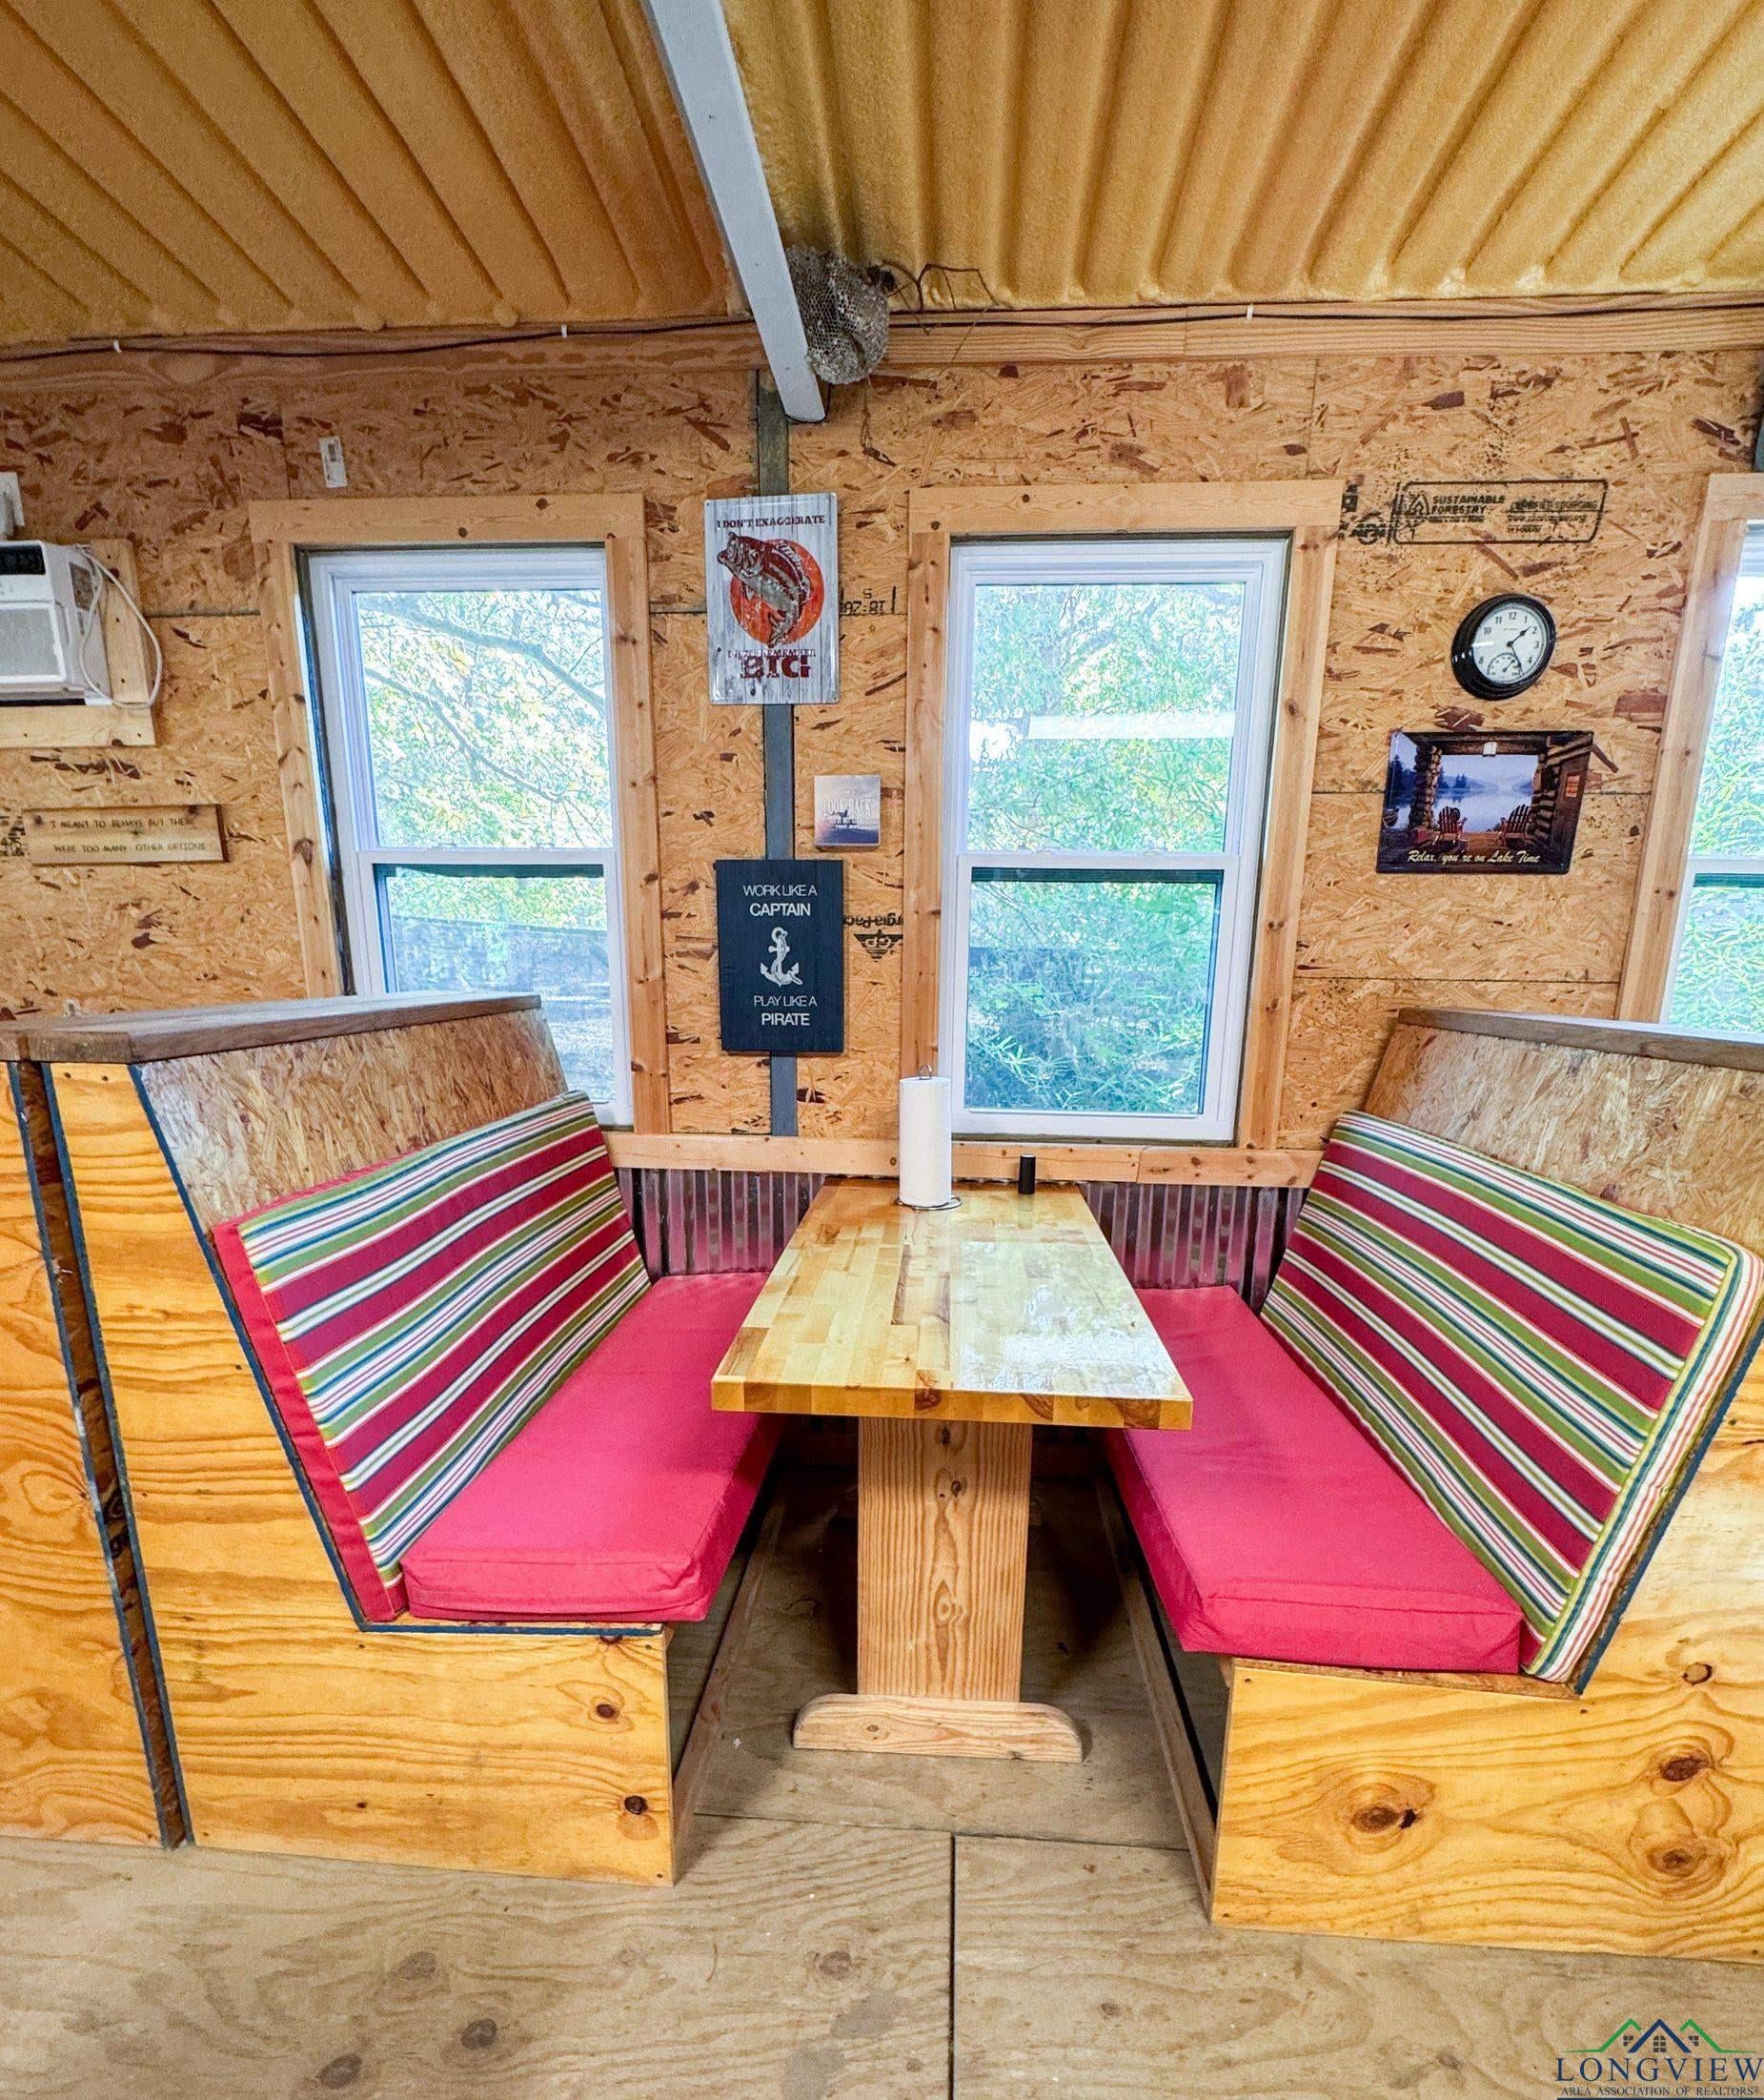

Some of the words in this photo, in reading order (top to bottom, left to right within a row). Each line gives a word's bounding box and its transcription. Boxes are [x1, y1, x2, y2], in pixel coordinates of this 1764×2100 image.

[1430, 505, 1487, 515] FORESTRY
[723, 520, 753, 528] DON'T
[755, 516, 825, 526] EXAGGERATE
[1509, 612, 1517, 621] 12
[1478, 656, 1484, 664] 8
[94, 820, 106, 828] TO
[135, 843, 164, 851] OTHER
[1488, 850, 1513, 863] Lake
[1516, 850, 1540, 864] Time
[742, 885, 781, 896] WORK
[782, 885, 806, 896] LIKE
[808, 885, 818, 896] A
[749, 903, 811, 916] CAPTAIN
[754, 995, 781, 1007] PLAY
[783, 995, 807, 1007] LIKE
[808, 995, 818, 1007] A
[761, 1012, 810, 1026] PIRATE
